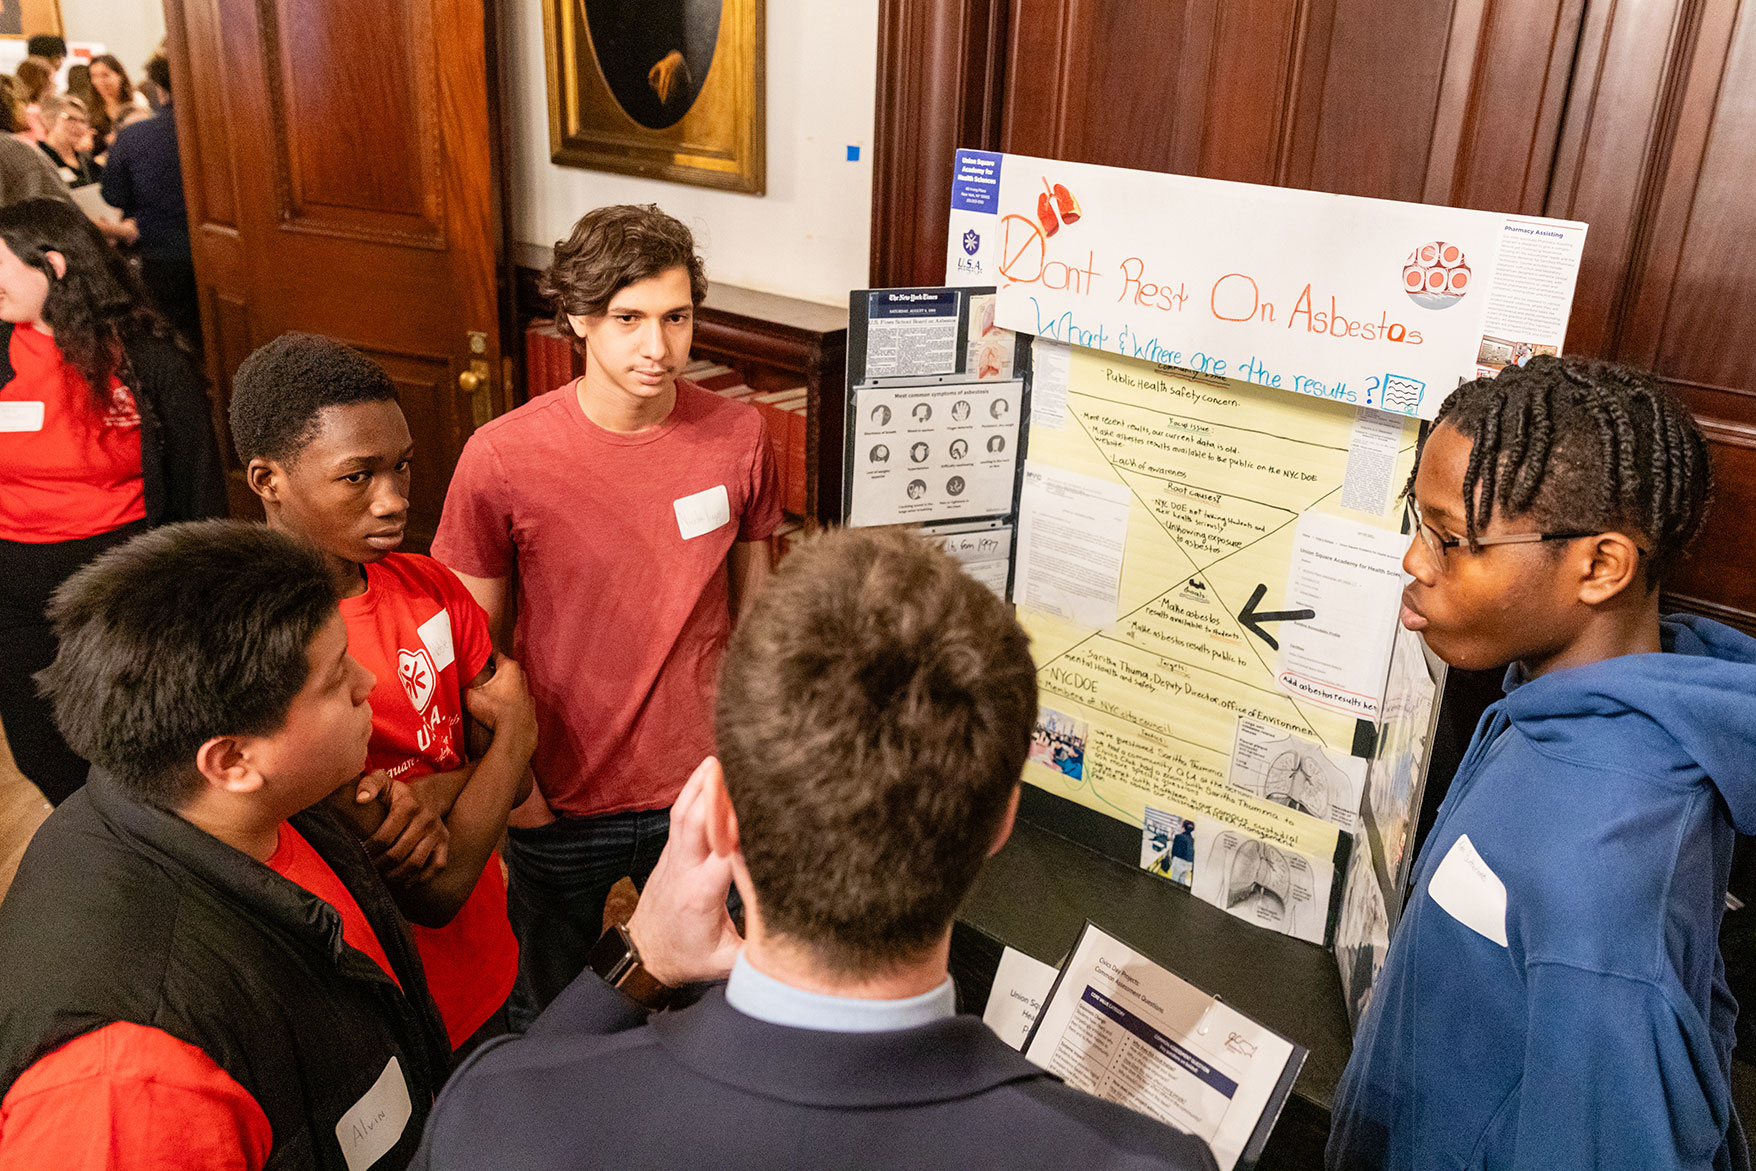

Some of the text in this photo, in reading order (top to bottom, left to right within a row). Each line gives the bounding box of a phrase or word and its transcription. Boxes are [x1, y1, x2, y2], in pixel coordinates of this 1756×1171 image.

[962, 166, 984, 175] Academy
[958, 174, 996, 184] Health Sciences
[1504, 225, 1564, 239] Pharmacy Assisting
[958, 257, 982, 270] U.S.A.
[998, 213, 1103, 296] Dont
[1117, 257, 1189, 312] Rest
[1210, 273, 1277, 323] On
[910, 294, 922, 302] York
[1029, 296, 1109, 350] What
[1132, 332, 1182, 365] Where
[1238, 356, 1282, 389] the
[1292, 374, 1358, 403] results
[1106, 369, 1135, 387] Public
[1137, 380, 1167, 393] Health
[1170, 387, 1200, 404] safety
[1101, 416, 1125, 428] recent
[1165, 432, 1194, 444] current
[1217, 443, 1224, 451] is
[1116, 432, 1144, 445] asbestos
[1146, 439, 1171, 452] results
[1208, 453, 1215, 461] to
[1229, 458, 1254, 469] public
[1268, 466, 1281, 475] the
[1283, 470, 1299, 480] NYC
[1300, 472, 1318, 482] DOE
[1138, 461, 1147, 471] of
[1167, 482, 1187, 496] Root
[1170, 501, 1187, 512] DOE
[1254, 524, 1266, 533] and
[1172, 512, 1193, 524] health
[1176, 535, 1184, 543] to
[1300, 548, 1314, 556] Union
[1315, 552, 1333, 561] Square
[1334, 557, 1358, 568] Academy
[1368, 566, 1385, 574] Health
[1145, 607, 1169, 620] results
[1205, 625, 1212, 633] to
[1185, 610, 1221, 626] asbestos
[1153, 629, 1185, 647] asbestos
[1211, 648, 1236, 663] public
[1238, 657, 1247, 667] to
[1119, 674, 1133, 684] and
[1153, 673, 1182, 695] Deputy
[1247, 708, 1258, 718] of
[1283, 676, 1297, 687] Add
[1299, 684, 1333, 700] asbestos
[1334, 694, 1361, 707] results
[1099, 701, 1121, 716] NYC
[1284, 818, 1295, 826] to
[1099, 957, 1112, 969] Civics
[1112, 965, 1121, 975] Day
[1010, 990, 1029, 1003] Union
[1095, 966, 1164, 1014] Common Assessment Questions
